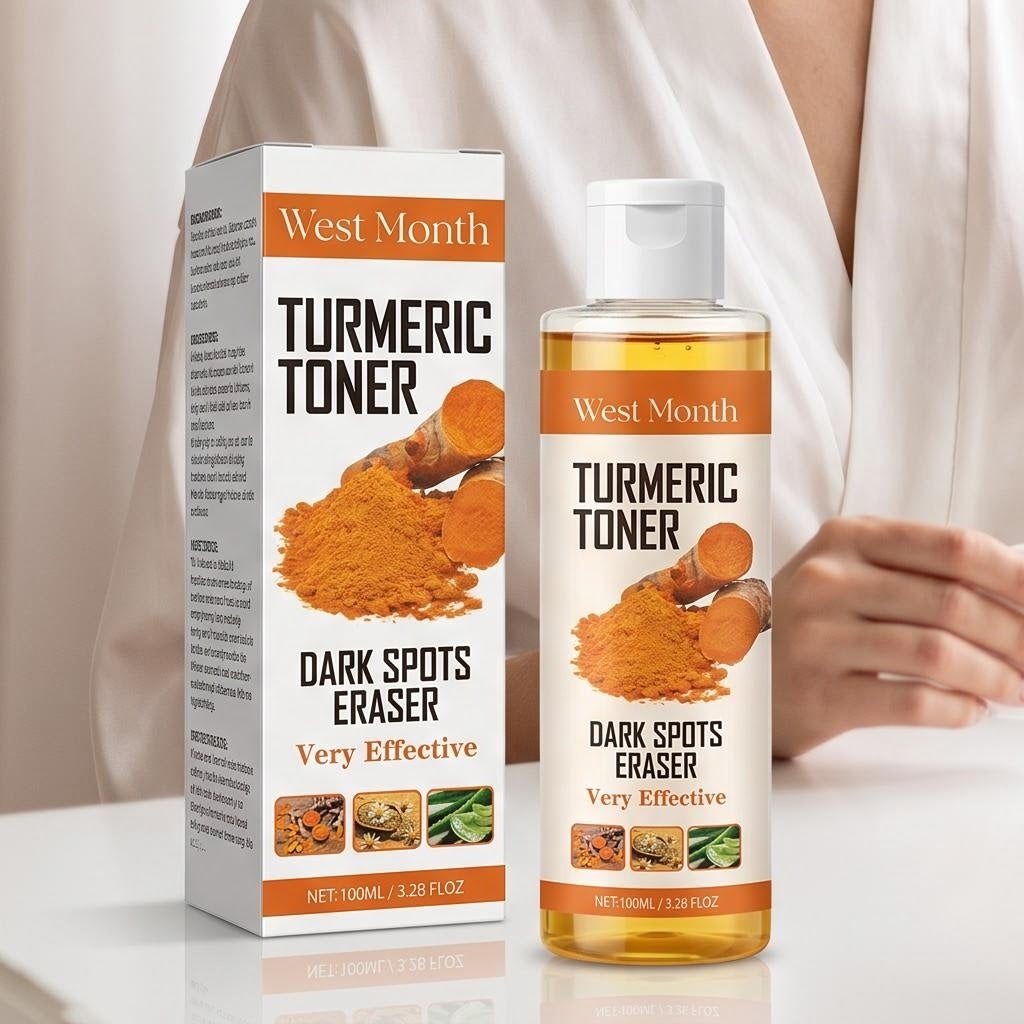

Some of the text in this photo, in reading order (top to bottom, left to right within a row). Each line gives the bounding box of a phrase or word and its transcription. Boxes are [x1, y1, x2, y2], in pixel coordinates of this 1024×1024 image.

[279, 208, 365, 242] West
[376, 212, 489, 245] Month
[278, 297, 491, 353] TURMERIC
[278, 359, 417, 414] TONER
[573, 398, 737, 422] West Month
[573, 463, 737, 503] TURMERIC
[573, 509, 679, 549] TONER
[301, 646, 471, 686] DARK SPOTS
[334, 687, 438, 725] ERASER
[590, 721, 722, 748] DARK SPOTS
[296, 737, 477, 769] Very Effective
[616, 752, 697, 778] ERASER
[586, 789, 726, 810] Very Effective
[398, 883, 425, 897] 3.28
[429, 880, 464, 896] FLOZ
[666, 897, 687, 908] 3.28
[691, 896, 719, 908] FLOZ
